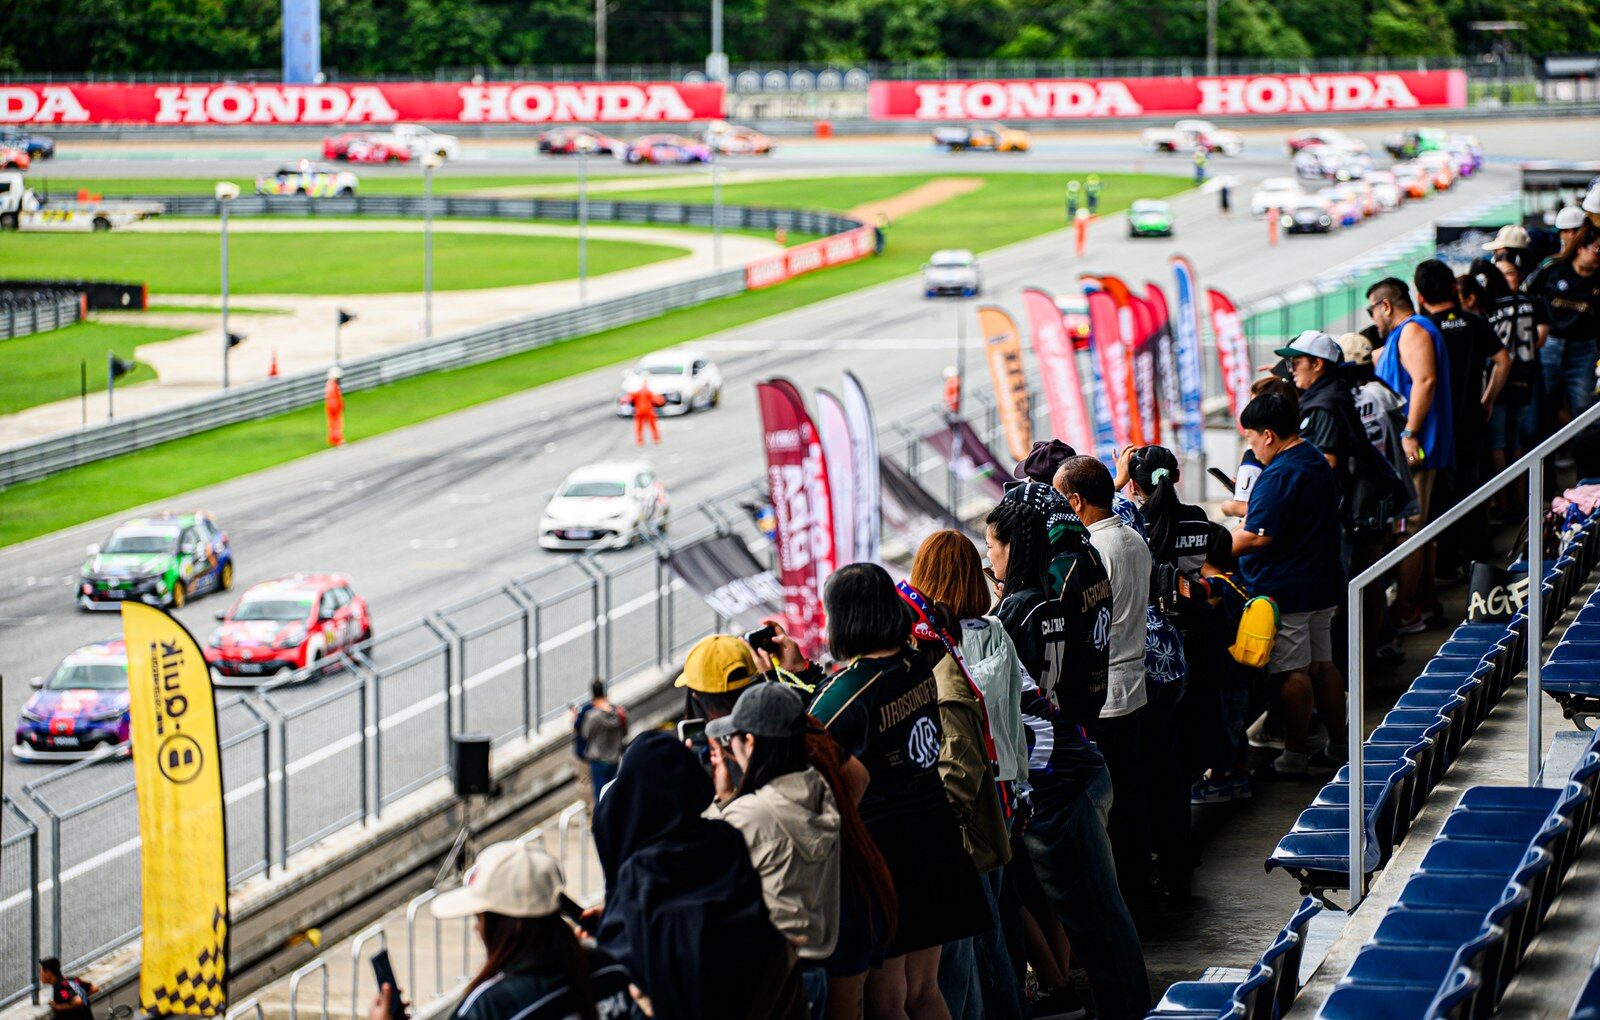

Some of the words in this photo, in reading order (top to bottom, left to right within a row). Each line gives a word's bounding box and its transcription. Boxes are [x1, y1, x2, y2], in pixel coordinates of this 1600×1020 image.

[155, 85, 398, 123] HONDA
[458, 84, 695, 121] HONDA
[916, 80, 1143, 120] HONDA
[1198, 73, 1421, 115] HONDA
